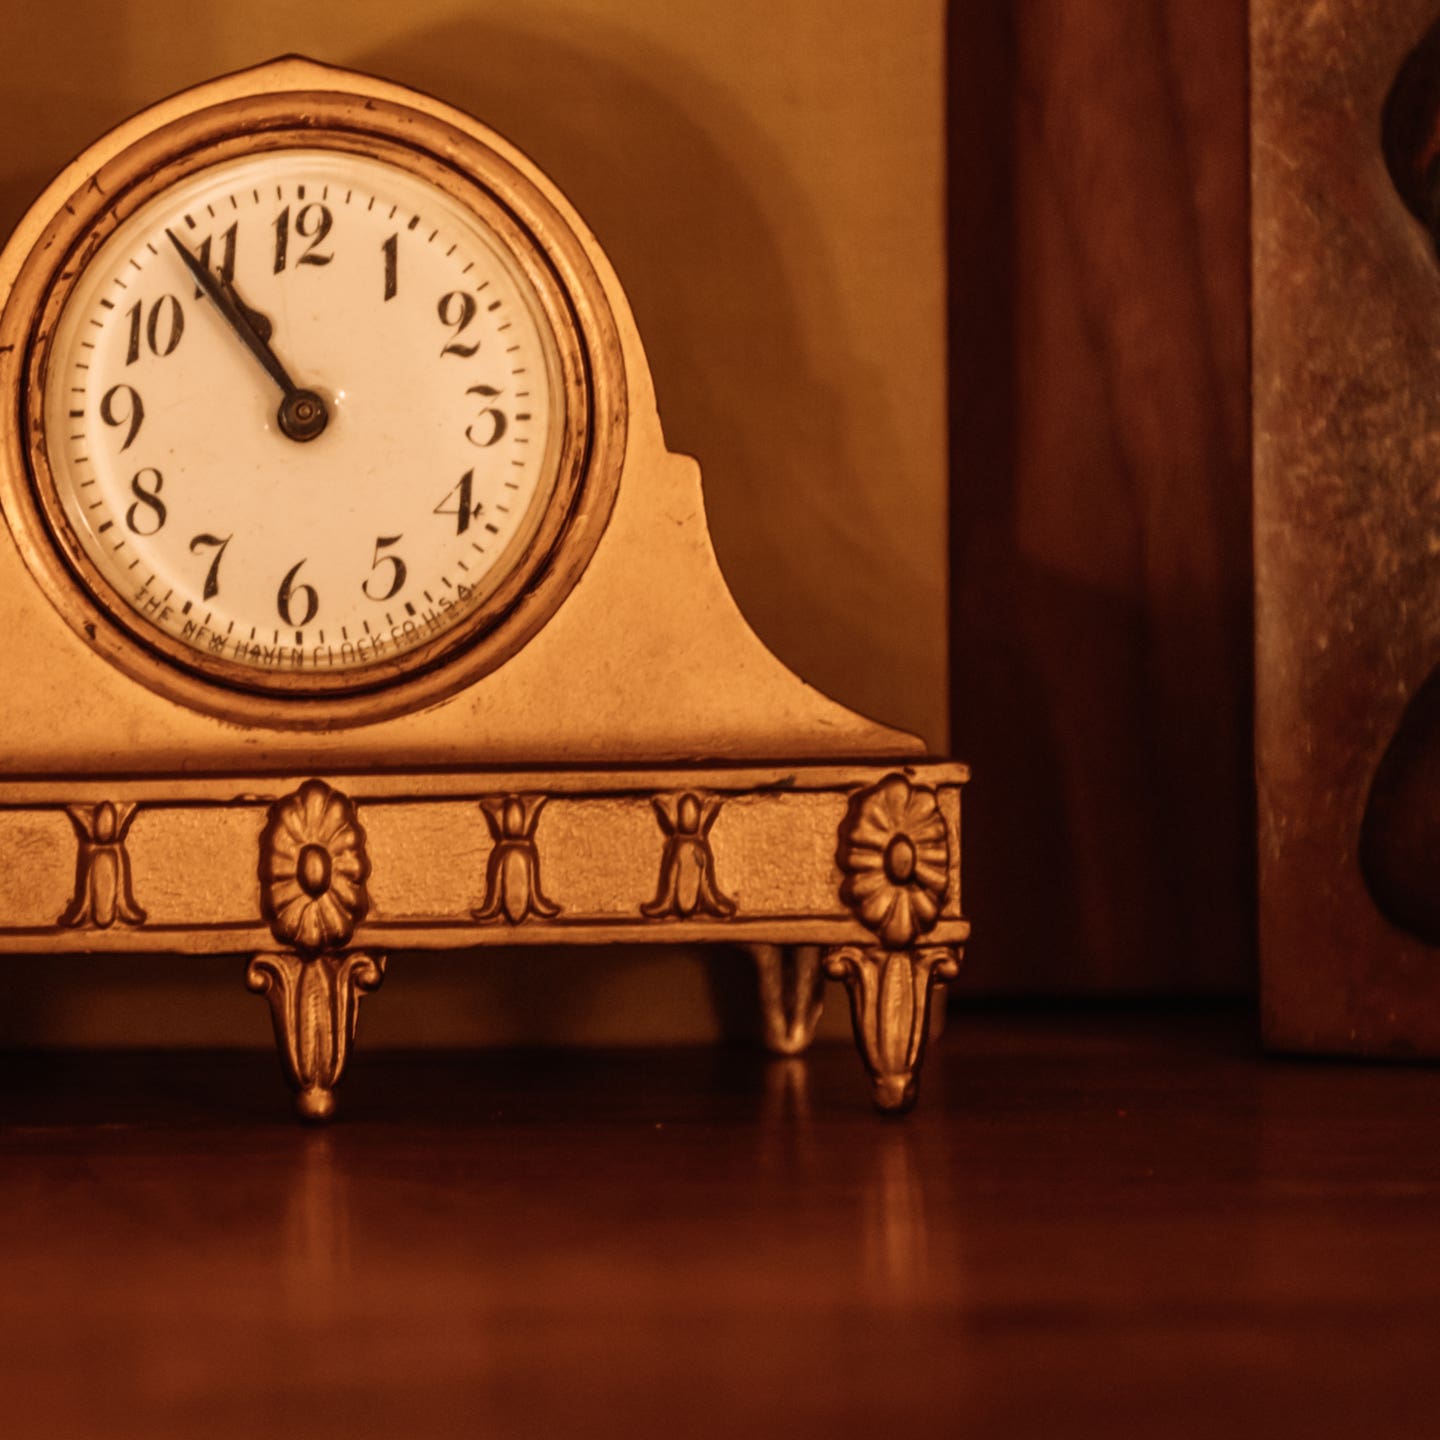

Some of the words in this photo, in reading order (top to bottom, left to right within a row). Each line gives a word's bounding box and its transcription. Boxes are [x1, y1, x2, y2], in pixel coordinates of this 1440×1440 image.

[271, 202, 335, 275] 12
[381, 232, 400, 302] 1
[124, 294, 185, 367] 10
[436, 290, 481, 358] 2
[99, 383, 146, 453] 9
[465, 384, 508, 447] 3
[125, 467, 168, 537] 8
[432, 468, 486, 537] 4
[189, 533, 234, 603] 7
[276, 558, 320, 628] 6
[361, 533, 408, 601] 5
